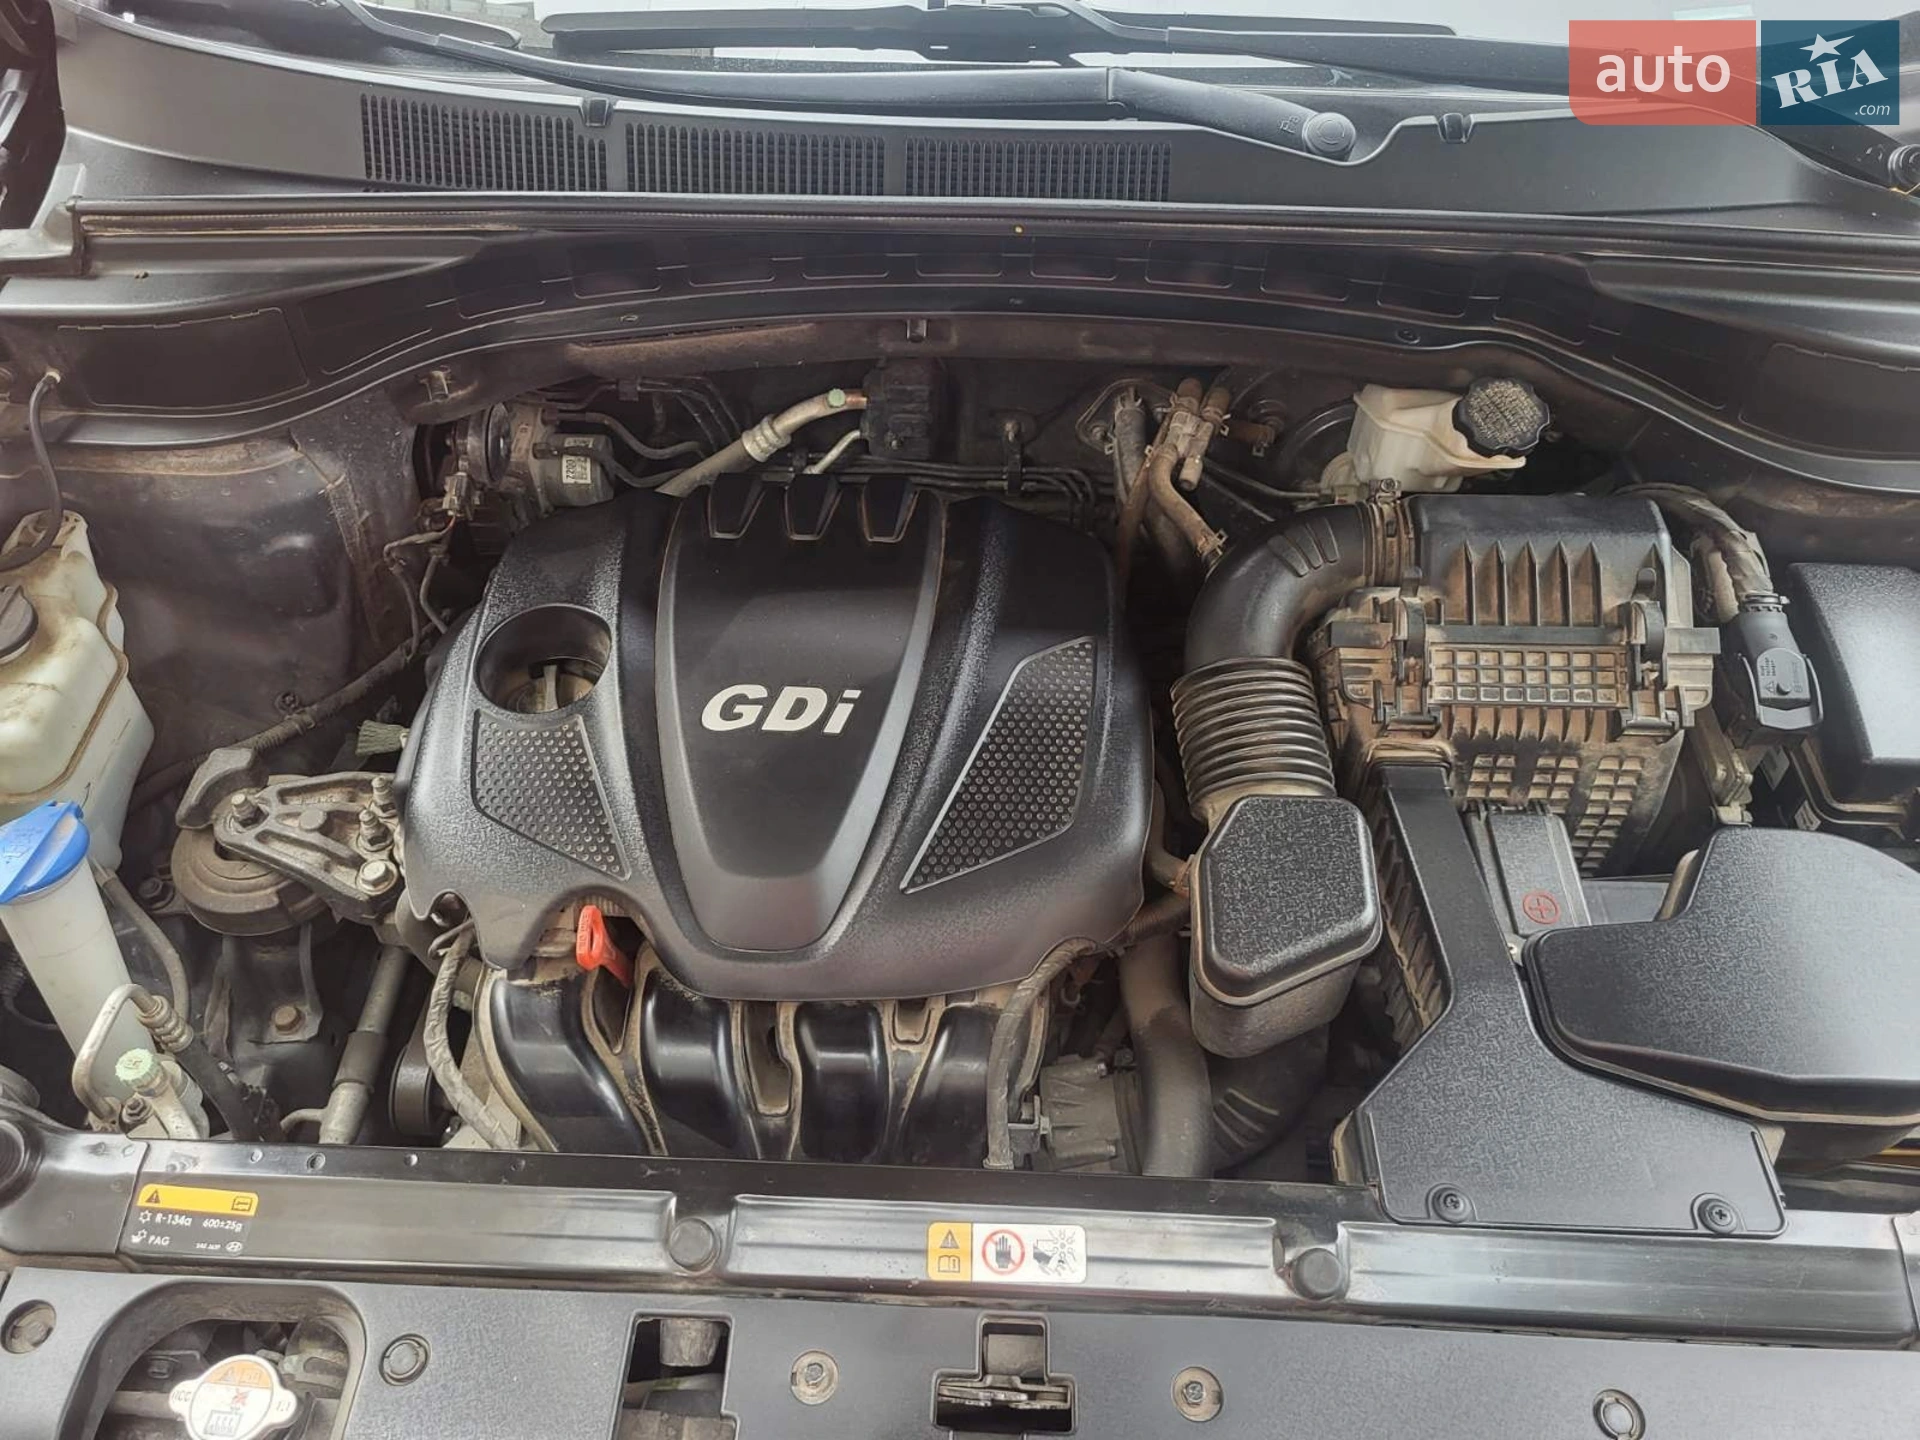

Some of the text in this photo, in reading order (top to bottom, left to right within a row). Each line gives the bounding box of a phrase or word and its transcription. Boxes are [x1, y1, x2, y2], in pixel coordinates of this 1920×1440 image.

[701, 684, 862, 734] GDi
[155, 1213, 193, 1227] R-134a
[148, 1235, 171, 1246] PAG
